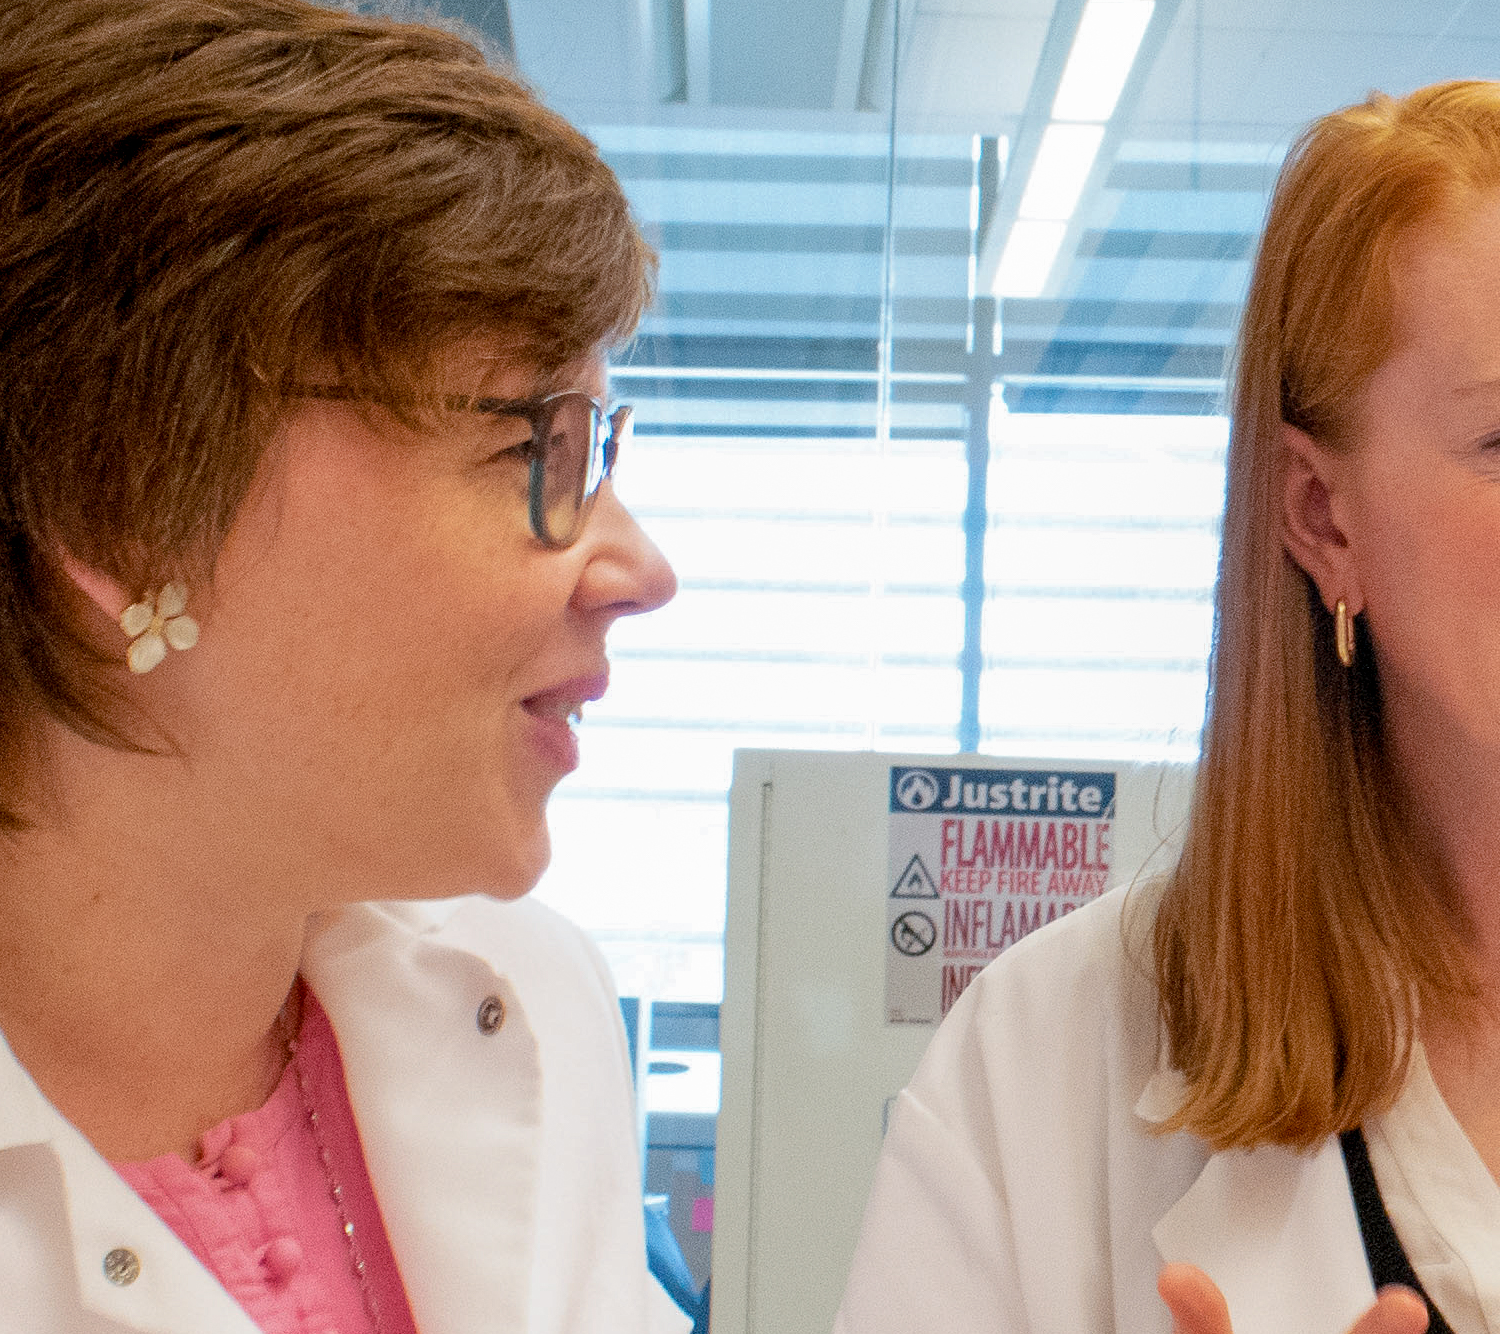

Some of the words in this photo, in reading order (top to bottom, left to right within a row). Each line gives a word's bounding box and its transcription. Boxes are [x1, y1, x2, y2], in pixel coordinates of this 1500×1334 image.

[943, 774, 1103, 814] Justrite
[941, 819, 1110, 870] FLAMMABLE
[939, 869, 992, 895] KEEP
[996, 870, 1042, 896] FIRE
[1046, 872, 1108, 898] AWAY
